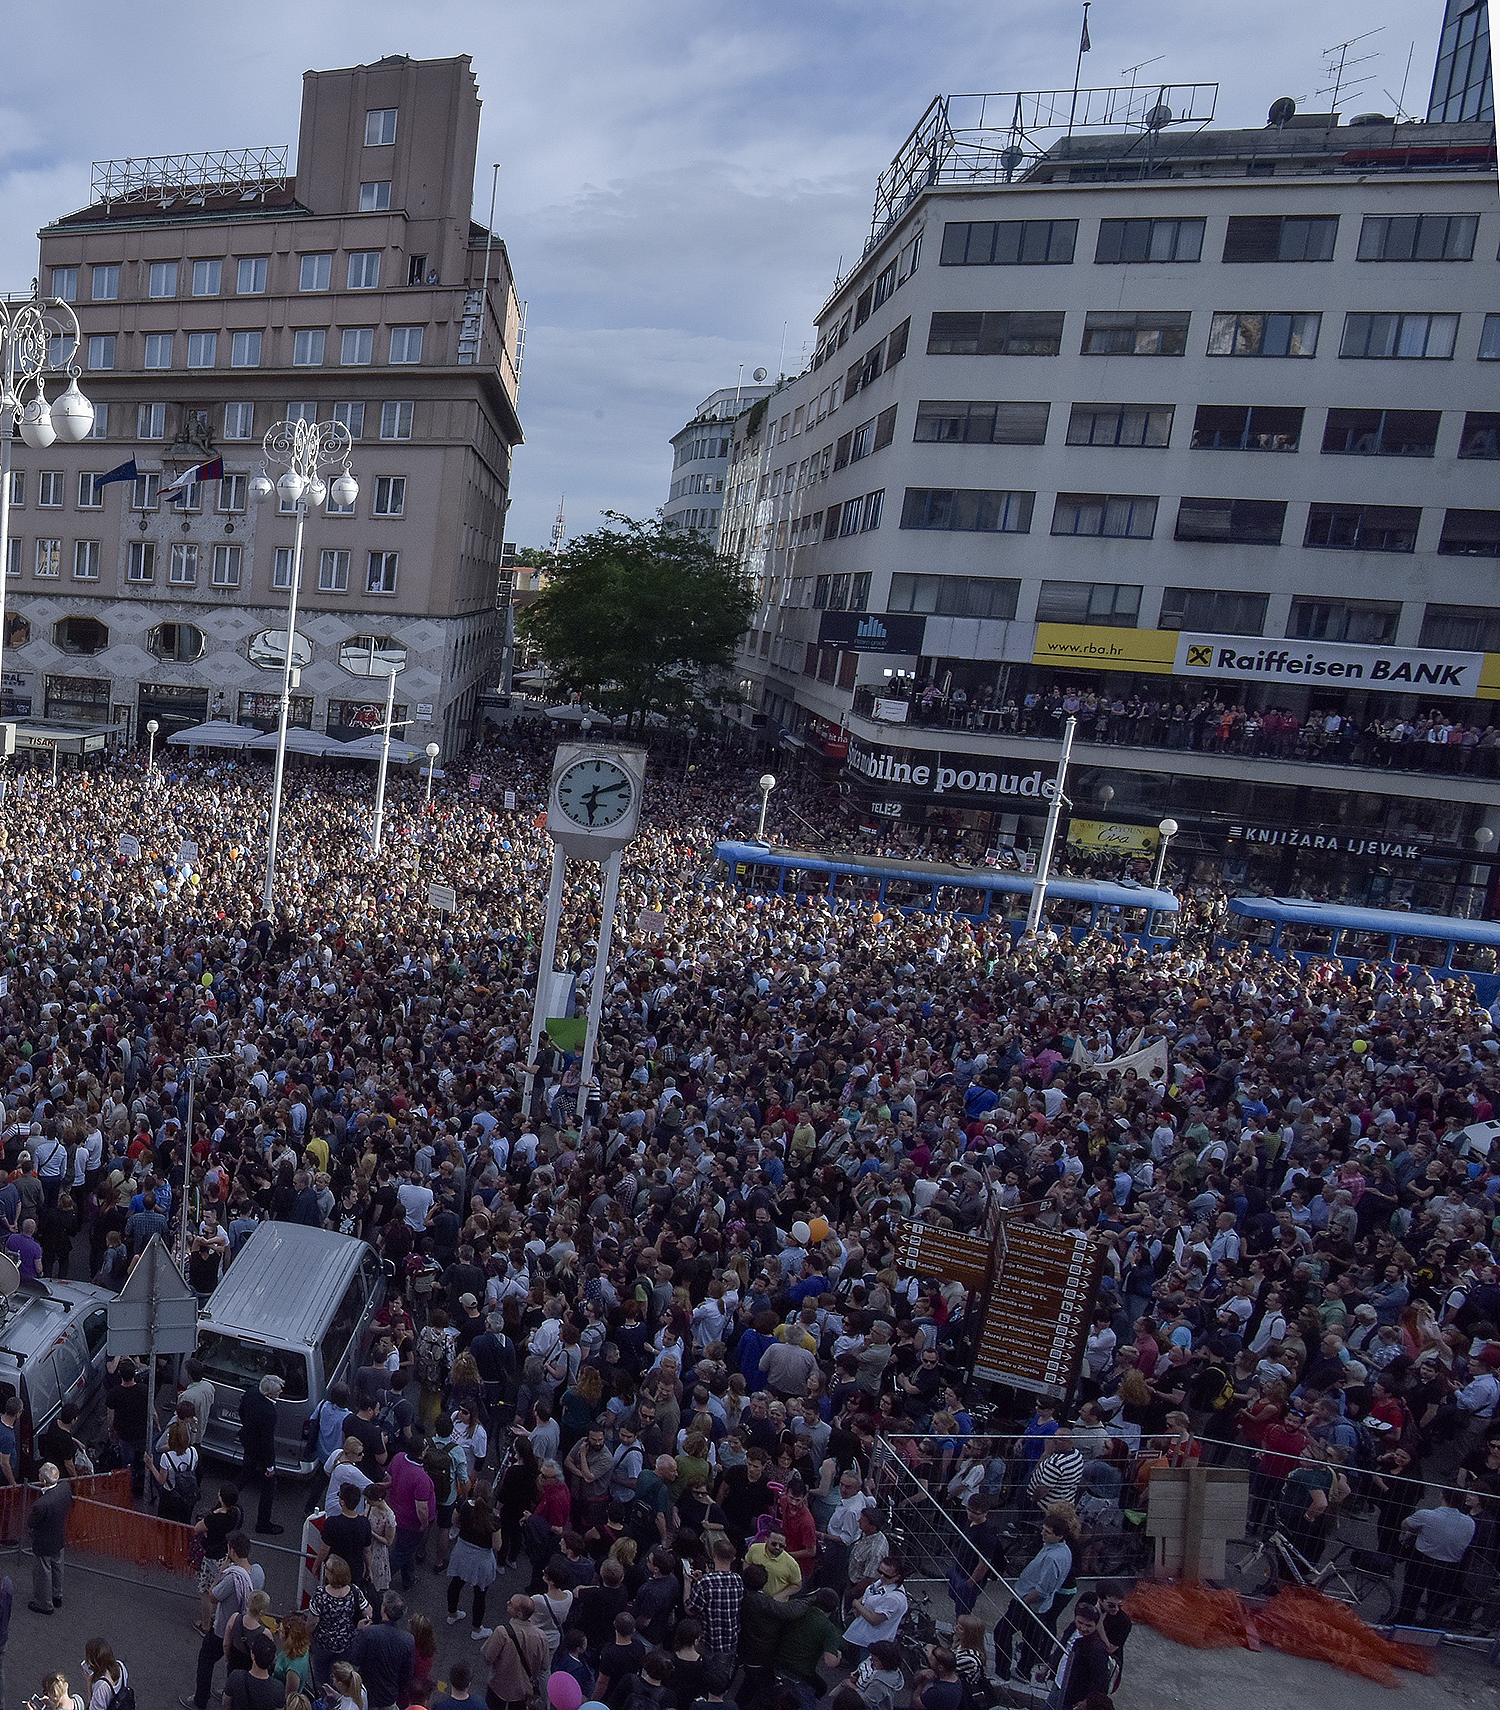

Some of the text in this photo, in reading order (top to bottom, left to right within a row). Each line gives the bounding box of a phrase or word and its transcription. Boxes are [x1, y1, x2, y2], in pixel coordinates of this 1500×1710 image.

[497, 543, 516, 607] HOTEL
[1047, 641, 1124, 656] www.rba.hr
[1217, 648, 1468, 687] Raiffeisen BANK
[29, 737, 54, 747] TISAK
[860, 752, 930, 785] mobilne
[933, 771, 1059, 799] ponude
[871, 802, 902, 817] TELE2
[1245, 828, 1418, 860] KNJIŽARA LJEVAK
[1007, 1223, 1023, 1232] Muzej
[1042, 1231, 1065, 1241] Zagreba
[917, 1262, 943, 1272] Katedrala
[1054, 1261, 1069, 1269] muzej
[1020, 1278, 1046, 1288] povijesni
[1047, 1285, 1064, 1293] muzej
[990, 1296, 1017, 1307] Kamenita
[1021, 1290, 1038, 1299] Marka
[986, 1320, 1008, 1329] Galerija
[1034, 1331, 1049, 1340] dvori
[983, 1331, 1001, 1341] Muzej
[1002, 1337, 1033, 1347] prekinutih
[978, 1354, 997, 1364] Državni
[1017, 1365, 1039, 1375] Zagrebu
[1012, 1351, 1028, 1360] Muzej
[1029, 1355, 1047, 1364] torture
